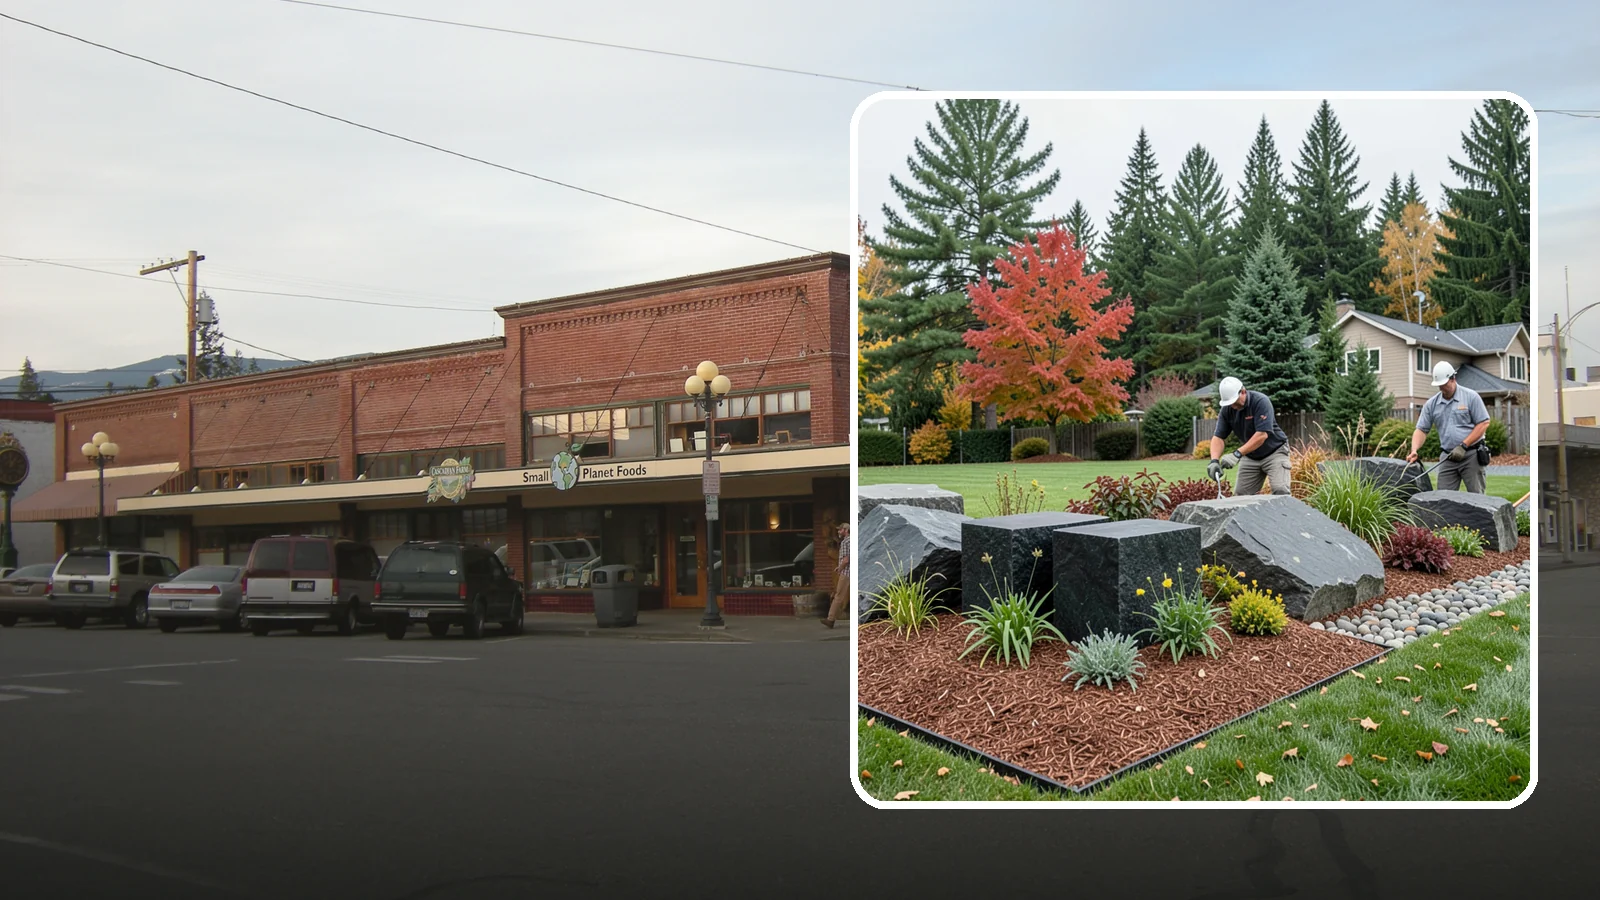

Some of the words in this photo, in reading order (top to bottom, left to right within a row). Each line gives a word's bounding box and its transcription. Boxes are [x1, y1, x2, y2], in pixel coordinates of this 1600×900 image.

[523, 472, 549, 483] Small
[583, 467, 614, 479] Planet
[617, 464, 647, 477] Foods
